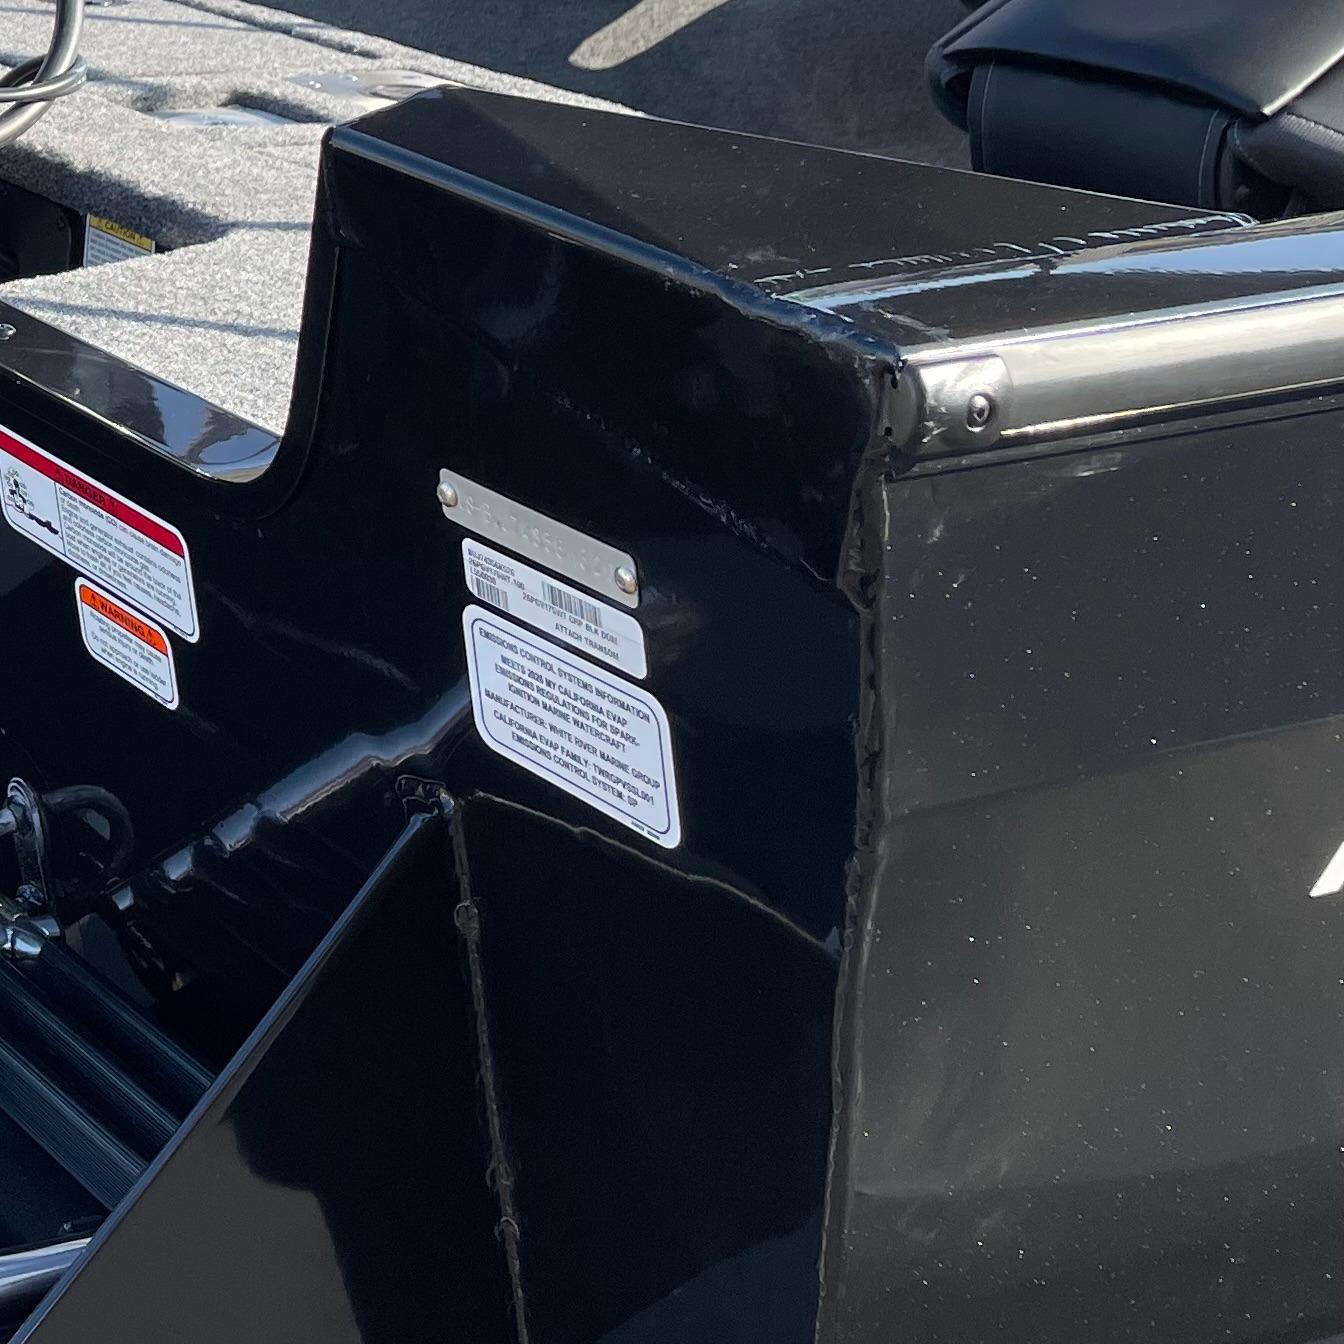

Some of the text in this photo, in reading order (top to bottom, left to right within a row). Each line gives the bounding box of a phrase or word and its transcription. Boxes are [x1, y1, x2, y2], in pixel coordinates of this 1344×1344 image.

[63, 472, 106, 507] DANGER
[98, 599, 145, 637] WARNING
[554, 621, 618, 660] ATTACH TRANSOM
[479, 627, 649, 723] EMISSIONS CONTROL SYSTEMS INFORMATION
[495, 663, 640, 748] EMISSIONS REGULATIONS FOR SPARK-
[501, 654, 525, 674] MEETS
[545, 678, 556, 690] MY
[558, 684, 603, 716] CALIFORNIA
[606, 710, 627, 728] EVAP
[483, 687, 660, 790] MANUFACTURER: WHITE RIVER MARINE GROUP
[494, 710, 536, 740] CALIFORNIA
[539, 734, 559, 752] EVAP
[561, 746, 590, 769] FAMILY:
[508, 683, 626, 753] IGNITION MARINE WATERCRAFT
[511, 731, 551, 760] EMISSIONS
[553, 755, 589, 781] CONTROL
[592, 776, 624, 801] SYSTEM:
